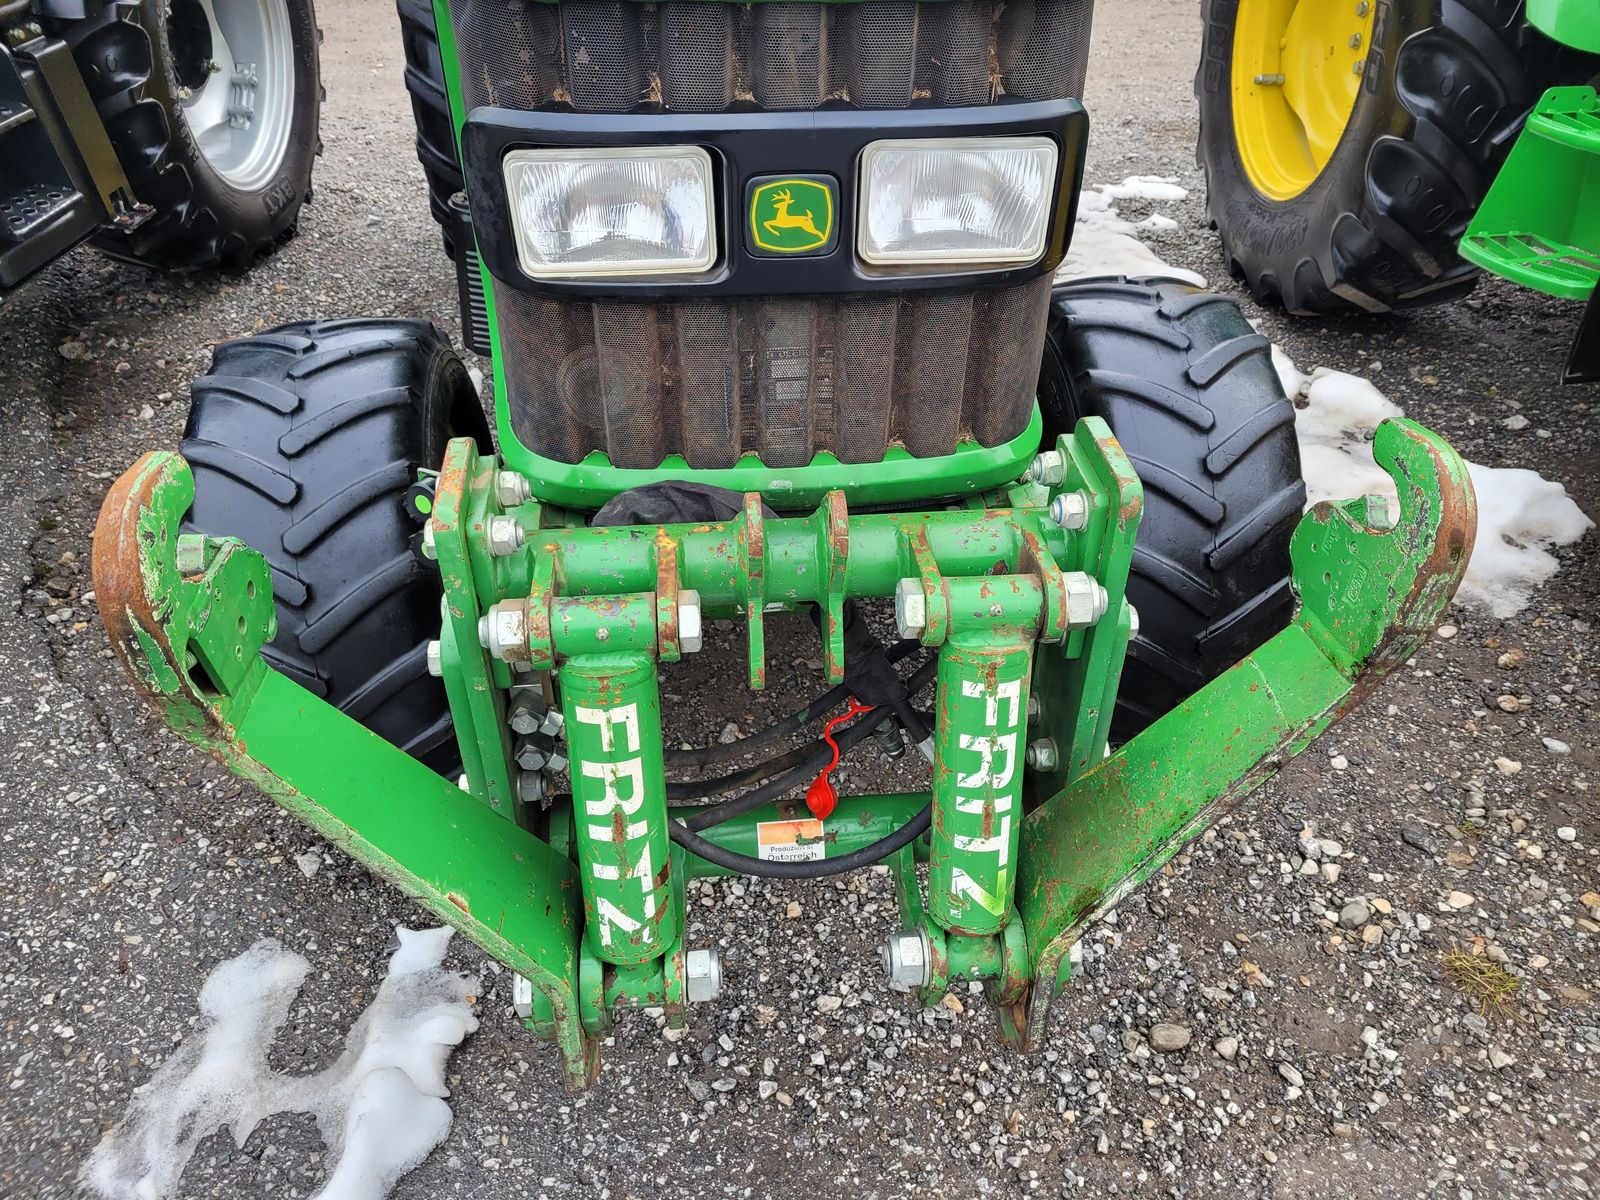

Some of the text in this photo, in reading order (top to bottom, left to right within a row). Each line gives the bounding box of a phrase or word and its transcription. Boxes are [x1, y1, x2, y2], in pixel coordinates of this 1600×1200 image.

[265, 177, 297, 217] BKT
[575, 702, 656, 946] FRITZ
[767, 851, 817, 861] Österreich
[950, 679, 1021, 919] FRITZ
